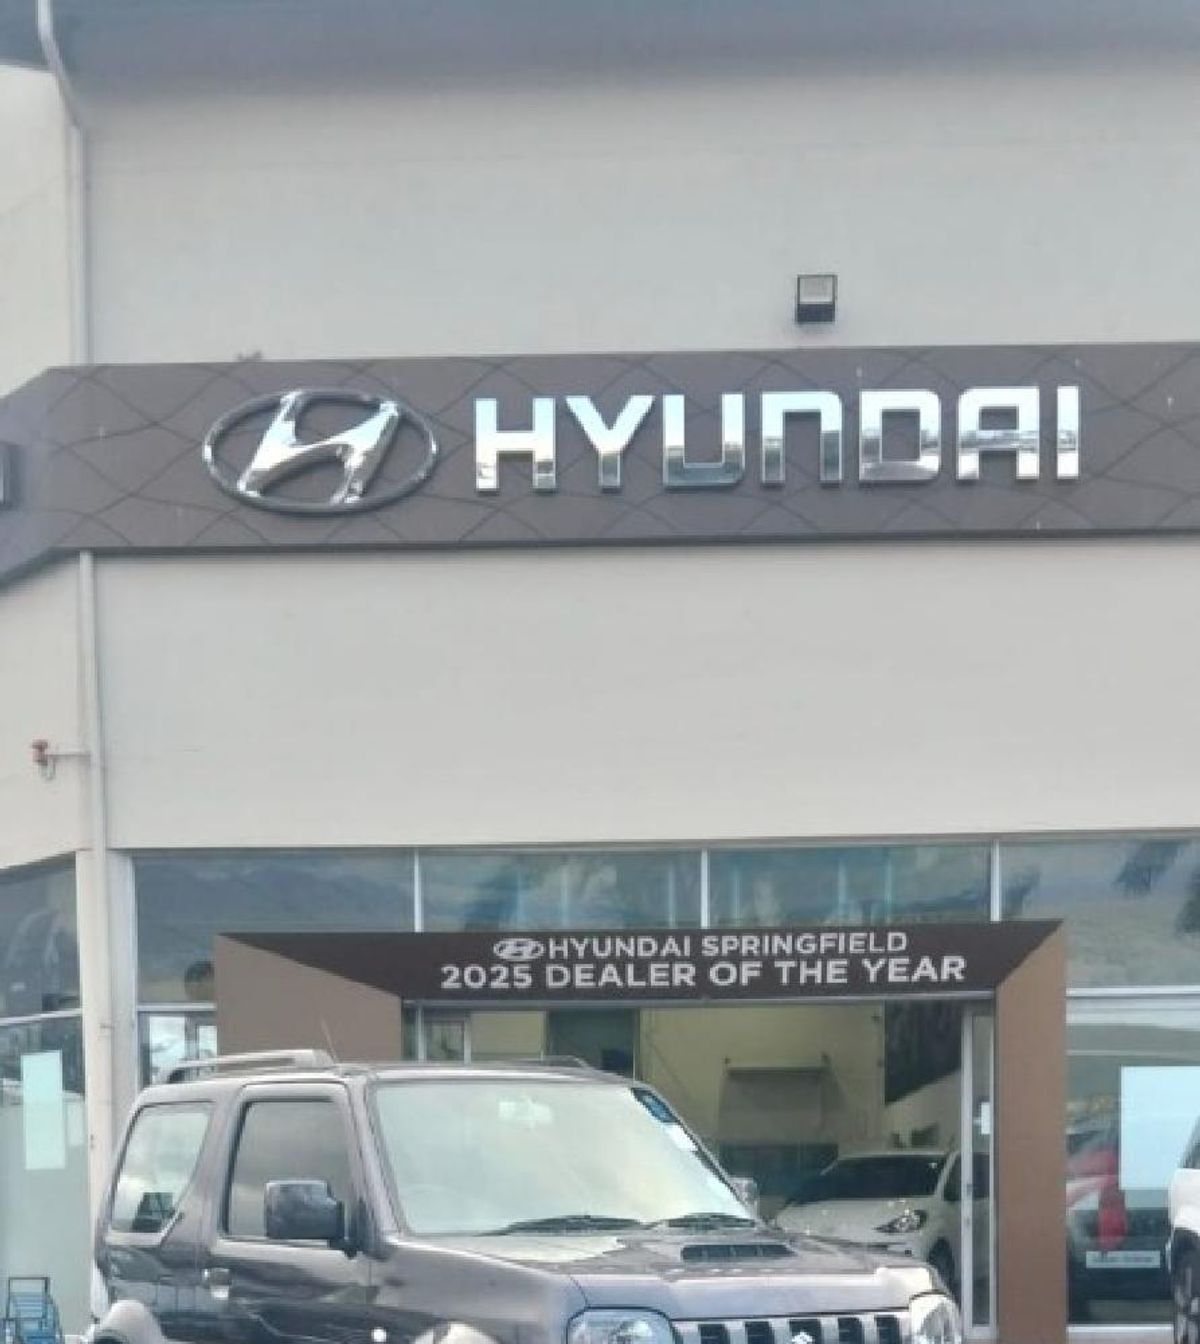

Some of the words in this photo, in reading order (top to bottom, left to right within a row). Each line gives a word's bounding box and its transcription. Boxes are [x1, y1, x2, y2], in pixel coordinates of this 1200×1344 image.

[475, 385, 1080, 492] HYUNDAI
[549, 935, 691, 959] HYUNDAI
[701, 931, 908, 957] SPRINGFIELD
[440, 964, 532, 989] 2025
[545, 962, 697, 988] DEALER
[709, 960, 763, 986] OF
[774, 959, 848, 985] THE
[861, 955, 966, 983] YEAR
